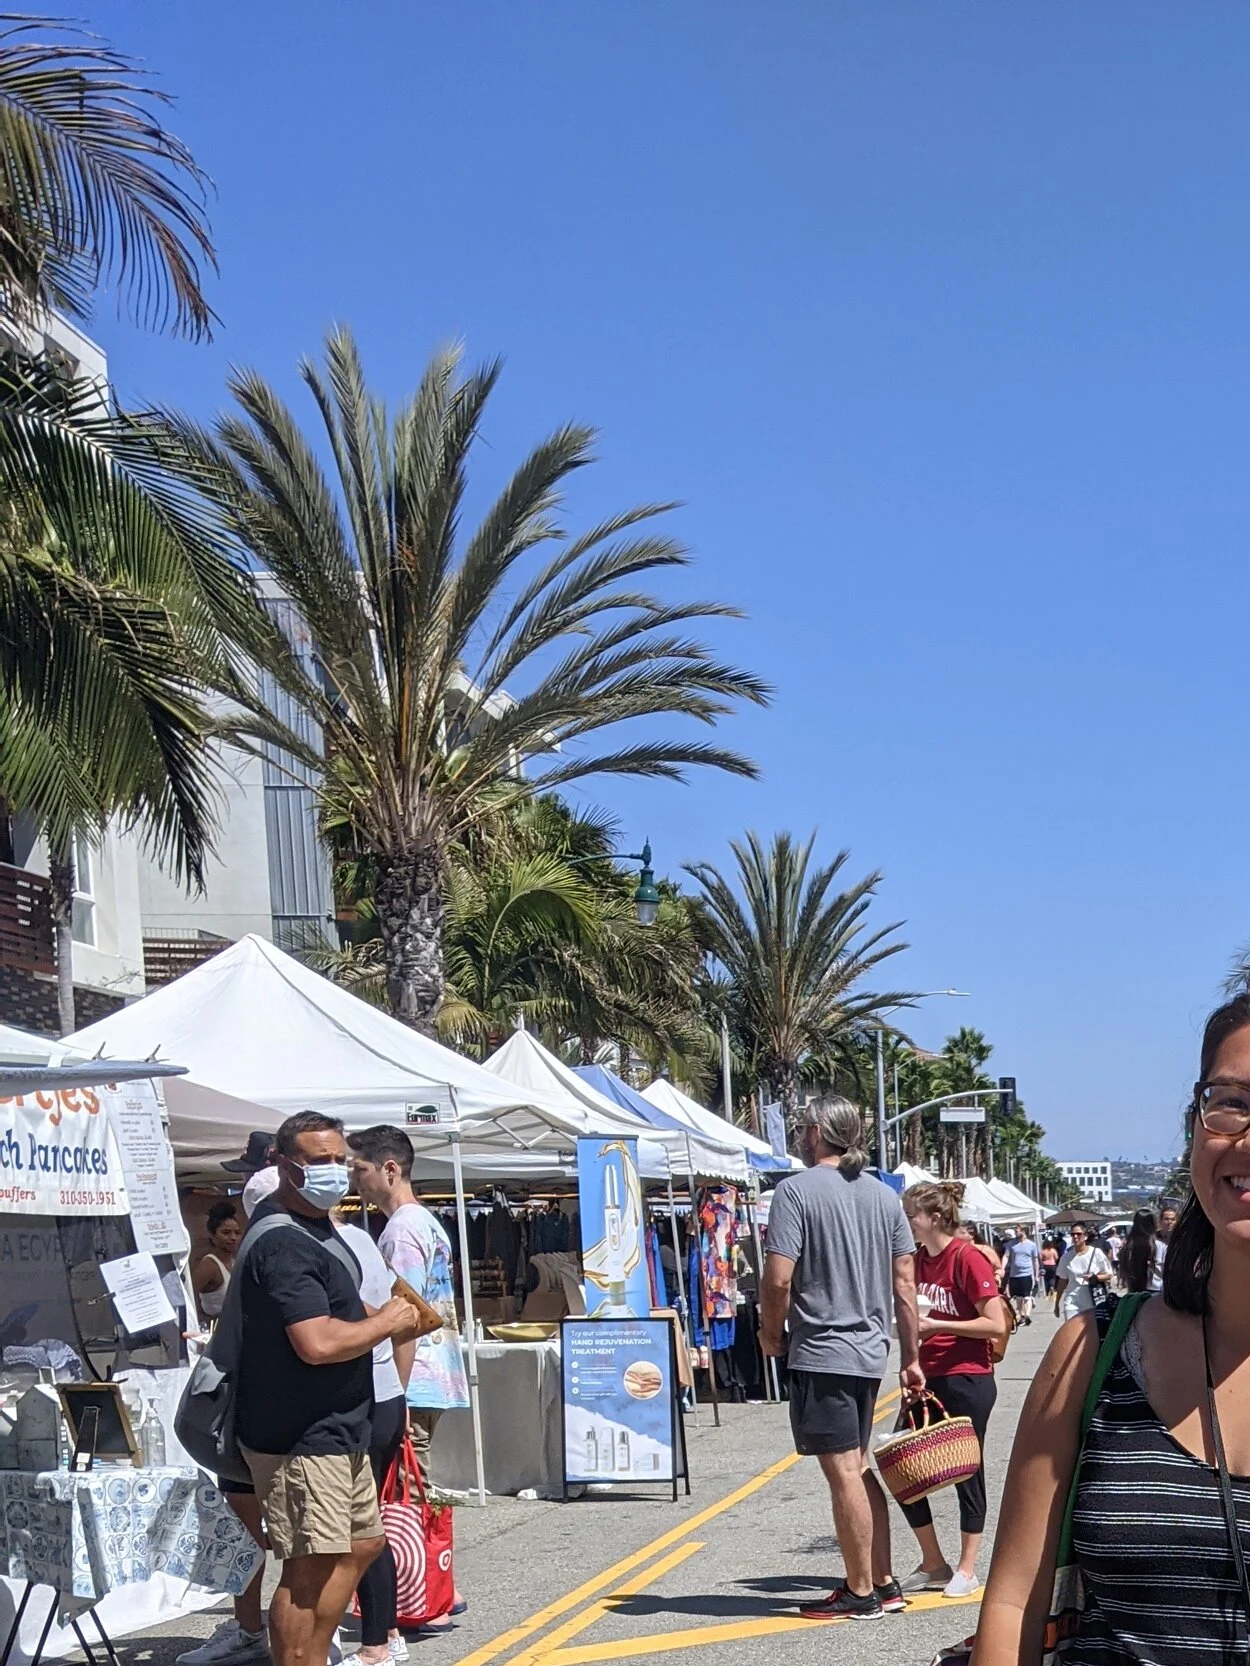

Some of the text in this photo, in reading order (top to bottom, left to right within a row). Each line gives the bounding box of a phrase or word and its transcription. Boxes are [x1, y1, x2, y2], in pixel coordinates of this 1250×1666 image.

[28, 1132, 108, 1175] Pancakes
[60, 1190, 116, 1205] 310-350-1951
[595, 1338, 651, 1346] REJUVENATION
